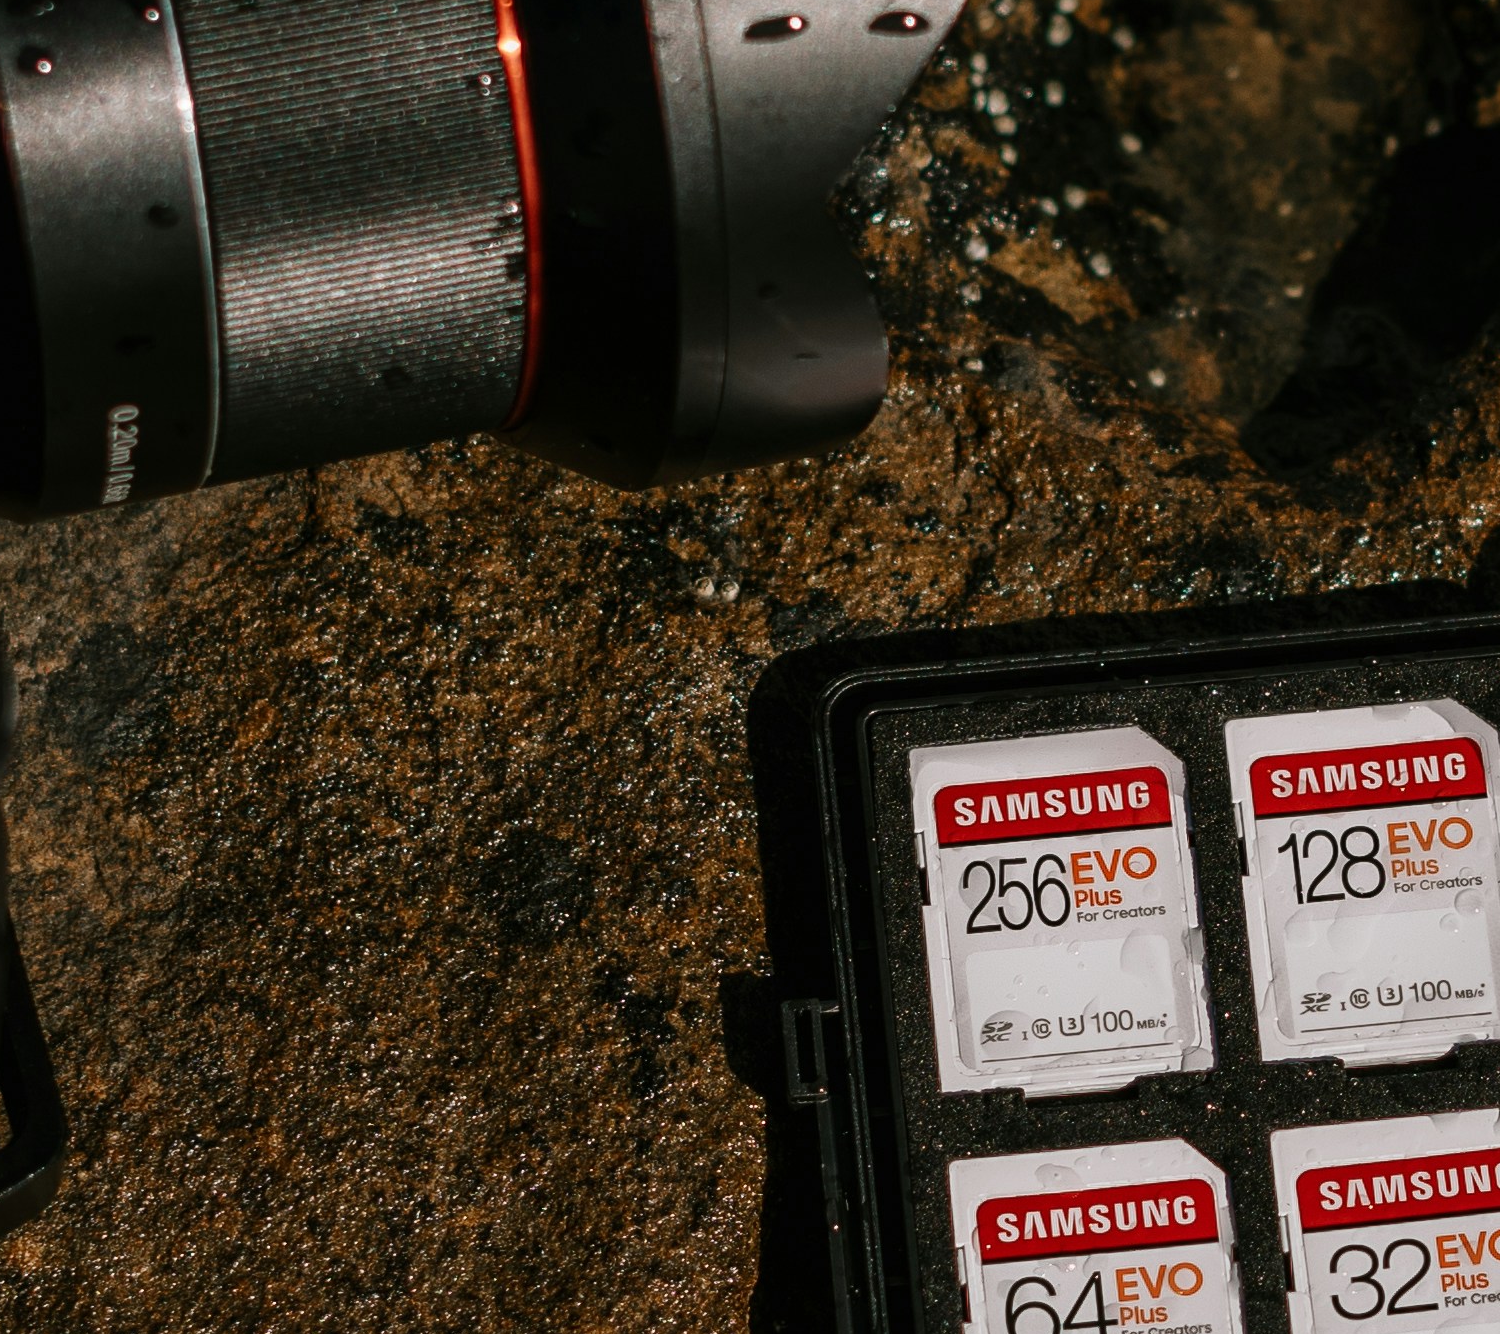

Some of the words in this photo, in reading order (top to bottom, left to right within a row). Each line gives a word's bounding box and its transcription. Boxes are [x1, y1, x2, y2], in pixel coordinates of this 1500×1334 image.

[1270, 753, 1467, 798] SAMSUNG
[954, 781, 1150, 826] SAMSUNG
[1278, 826, 1386, 905] 128
[1387, 817, 1473, 855] EVO
[1391, 859, 1440, 878] Plus
[962, 854, 1071, 934] 256
[1070, 846, 1157, 885] EVO
[1394, 882, 1415, 894] For
[1420, 875, 1483, 891] Creators
[1075, 889, 1122, 908] Plus
[1077, 911, 1098, 923] For
[1103, 905, 1166, 921] Creators
[1409, 979, 1452, 1003] 100
[1091, 1010, 1133, 1033] 100
[996, 1195, 1197, 1243] SAMSUNG
[1115, 1262, 1204, 1302] EVO
[1329, 1238, 1439, 1321] 32
[1440, 1272, 1489, 1292] Plus
[1444, 1296, 1467, 1308] For
[1119, 1305, 1169, 1326] Plus
